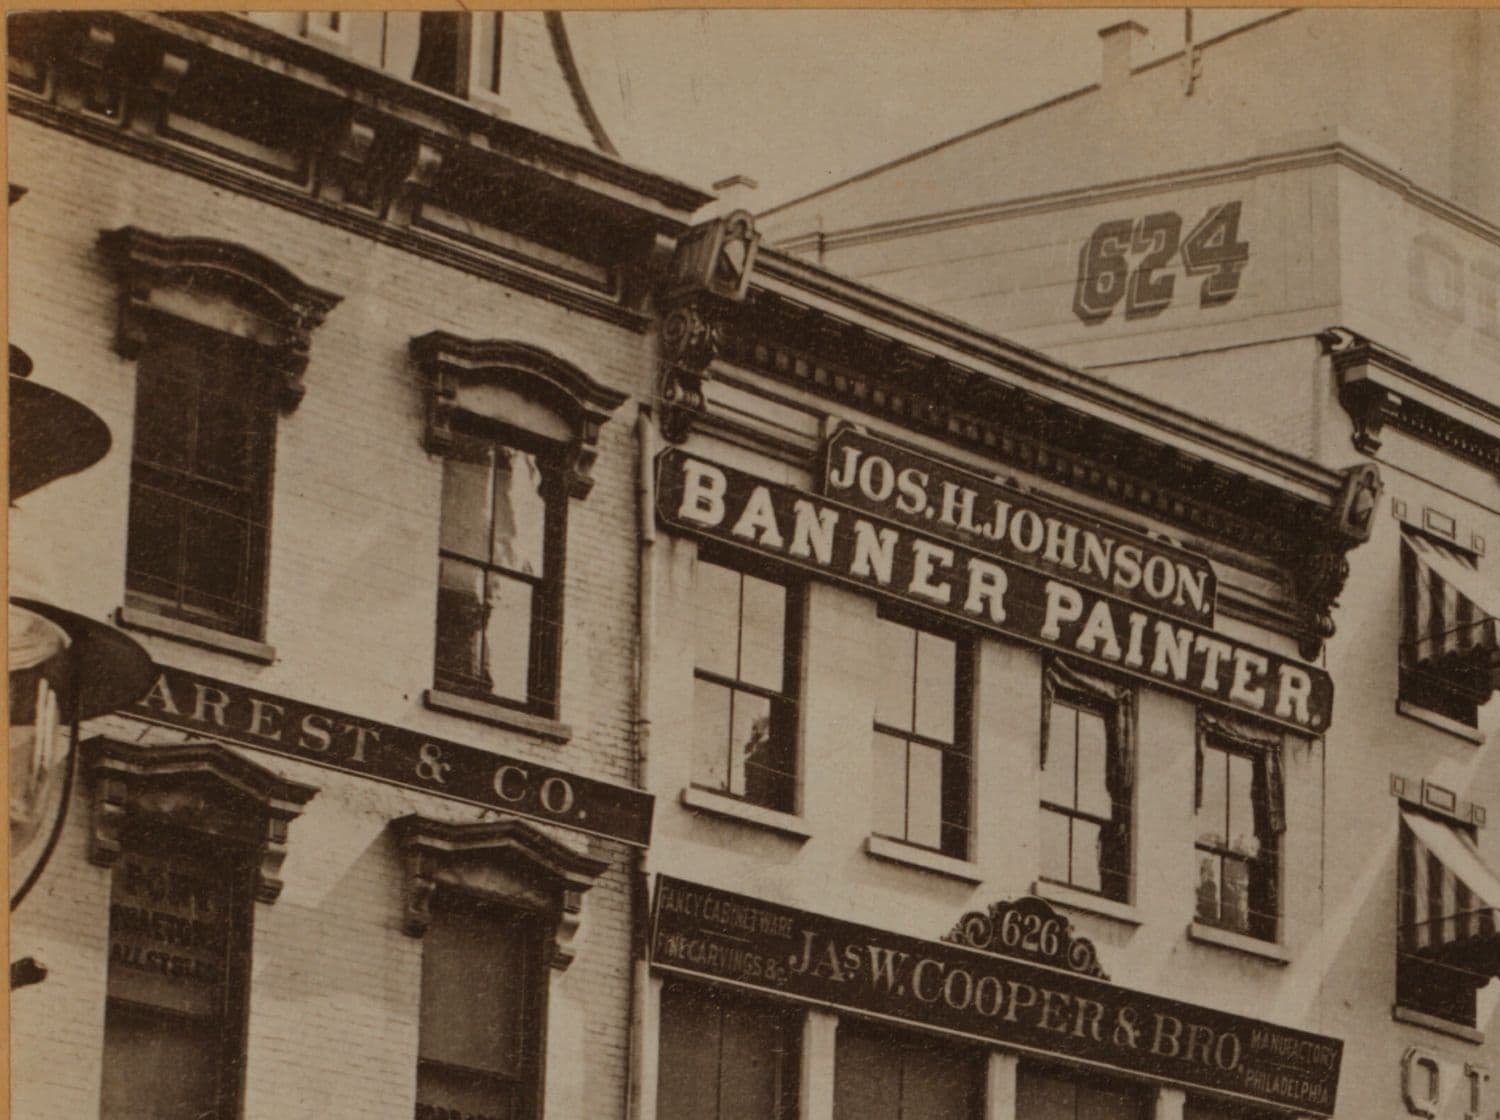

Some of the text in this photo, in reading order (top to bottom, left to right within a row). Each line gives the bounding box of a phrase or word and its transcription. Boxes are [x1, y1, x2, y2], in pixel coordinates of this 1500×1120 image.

[1072, 199, 1250, 327] 624
[677, 459, 1321, 728] BANNER PAINTER.
[831, 445, 1211, 616] JOS. H. JOHNSON.
[139, 674, 588, 820] AREST & CO.
[999, 909, 1061, 958] 626
[862, 946, 906, 997] W.
[911, 959, 1105, 1043] COOPER
[1112, 1007, 1142, 1049] &
[1152, 1012, 1245, 1073] BRO.
